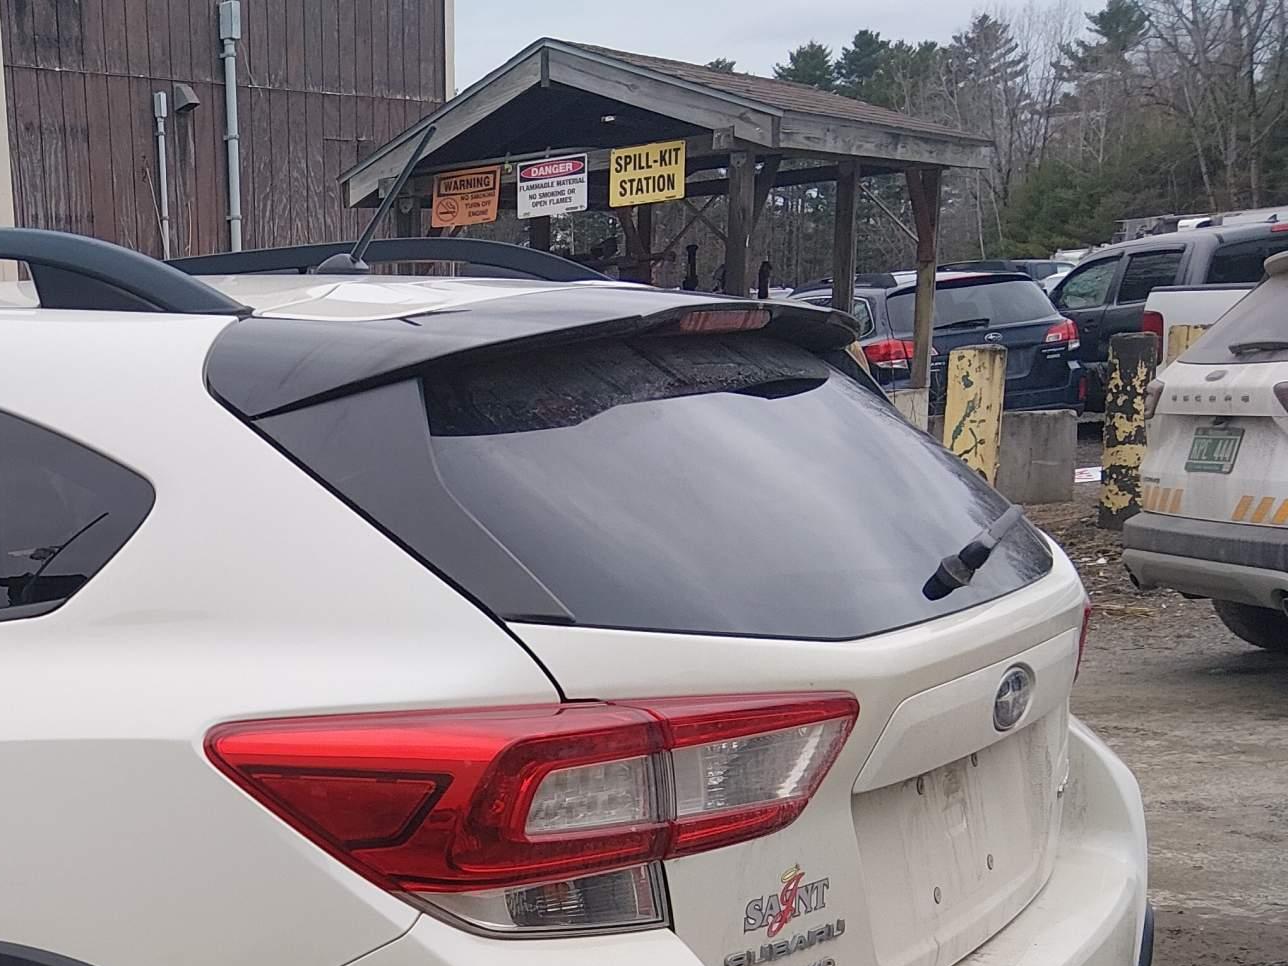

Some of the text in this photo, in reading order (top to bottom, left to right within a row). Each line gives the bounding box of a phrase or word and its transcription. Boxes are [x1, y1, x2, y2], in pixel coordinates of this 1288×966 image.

[615, 147, 681, 174] SPILL-KIT
[531, 162, 573, 177] DANGER
[443, 175, 491, 193] WARNING
[519, 180, 554, 192] FLAMMABLE
[619, 173, 675, 197] STATION
[538, 189, 566, 199] SMOKING
[567, 187, 576, 195] OR
[531, 196, 573, 208] OPEN FLAMES
